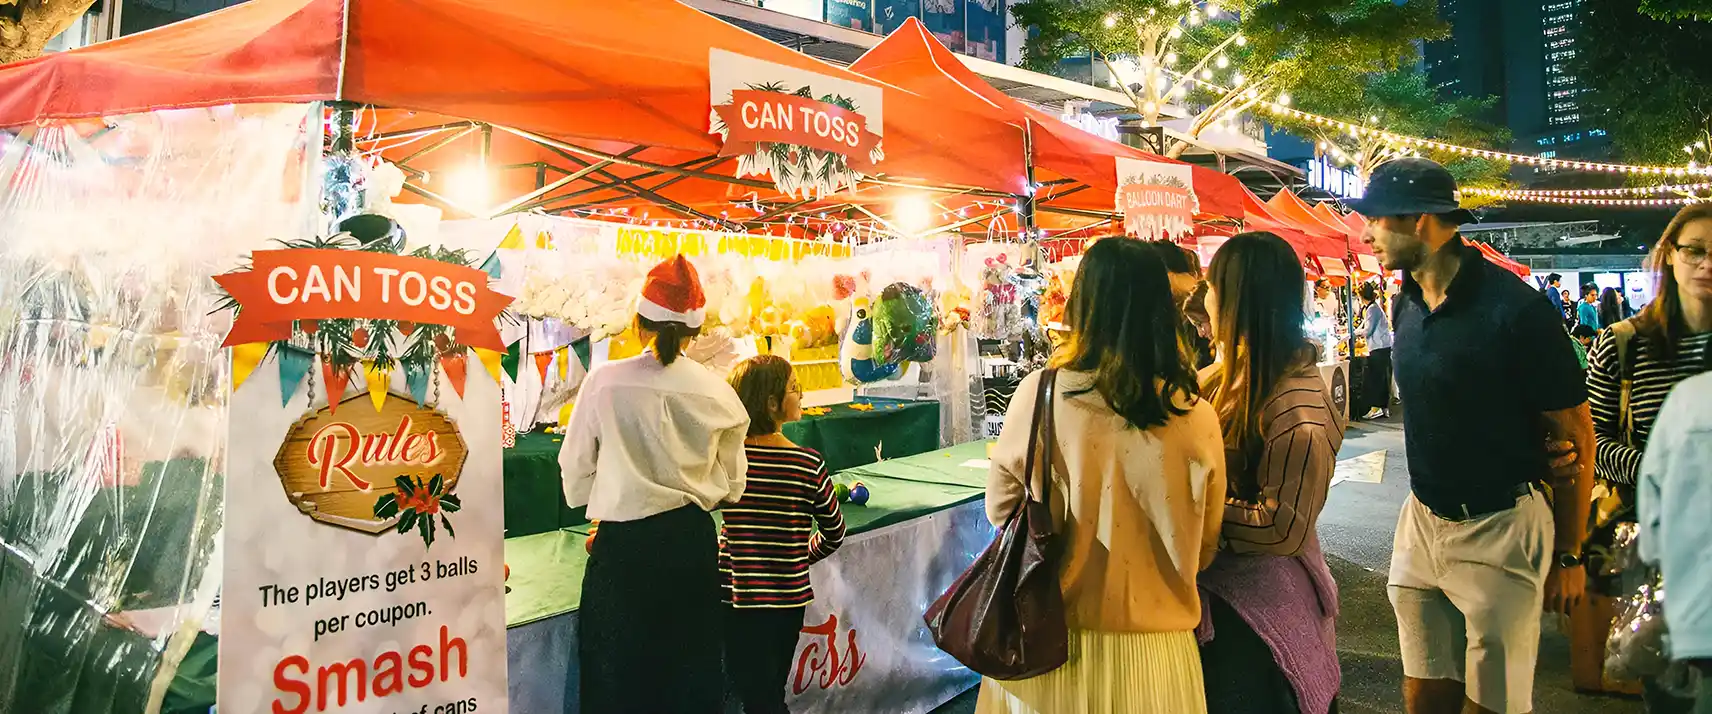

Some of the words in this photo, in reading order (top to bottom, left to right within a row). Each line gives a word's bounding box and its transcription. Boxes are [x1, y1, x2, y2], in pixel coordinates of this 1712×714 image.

[741, 100, 793, 131] CAN
[799, 107, 859, 147] TOSS
[1126, 190, 1164, 209] BALLOON
[1165, 191, 1187, 209] DART
[267, 265, 361, 304] CAN
[373, 267, 476, 315] TOSS
[307, 414, 444, 494] Rules
[259, 584, 299, 607] The
[306, 573, 380, 606] players
[385, 564, 415, 592] get
[420, 561, 431, 581] 3
[436, 556, 478, 579] balls
[314, 615, 349, 642] per
[355, 601, 432, 628] coupon.
[271, 625, 467, 714] Smash
[434, 697, 477, 714] cans
